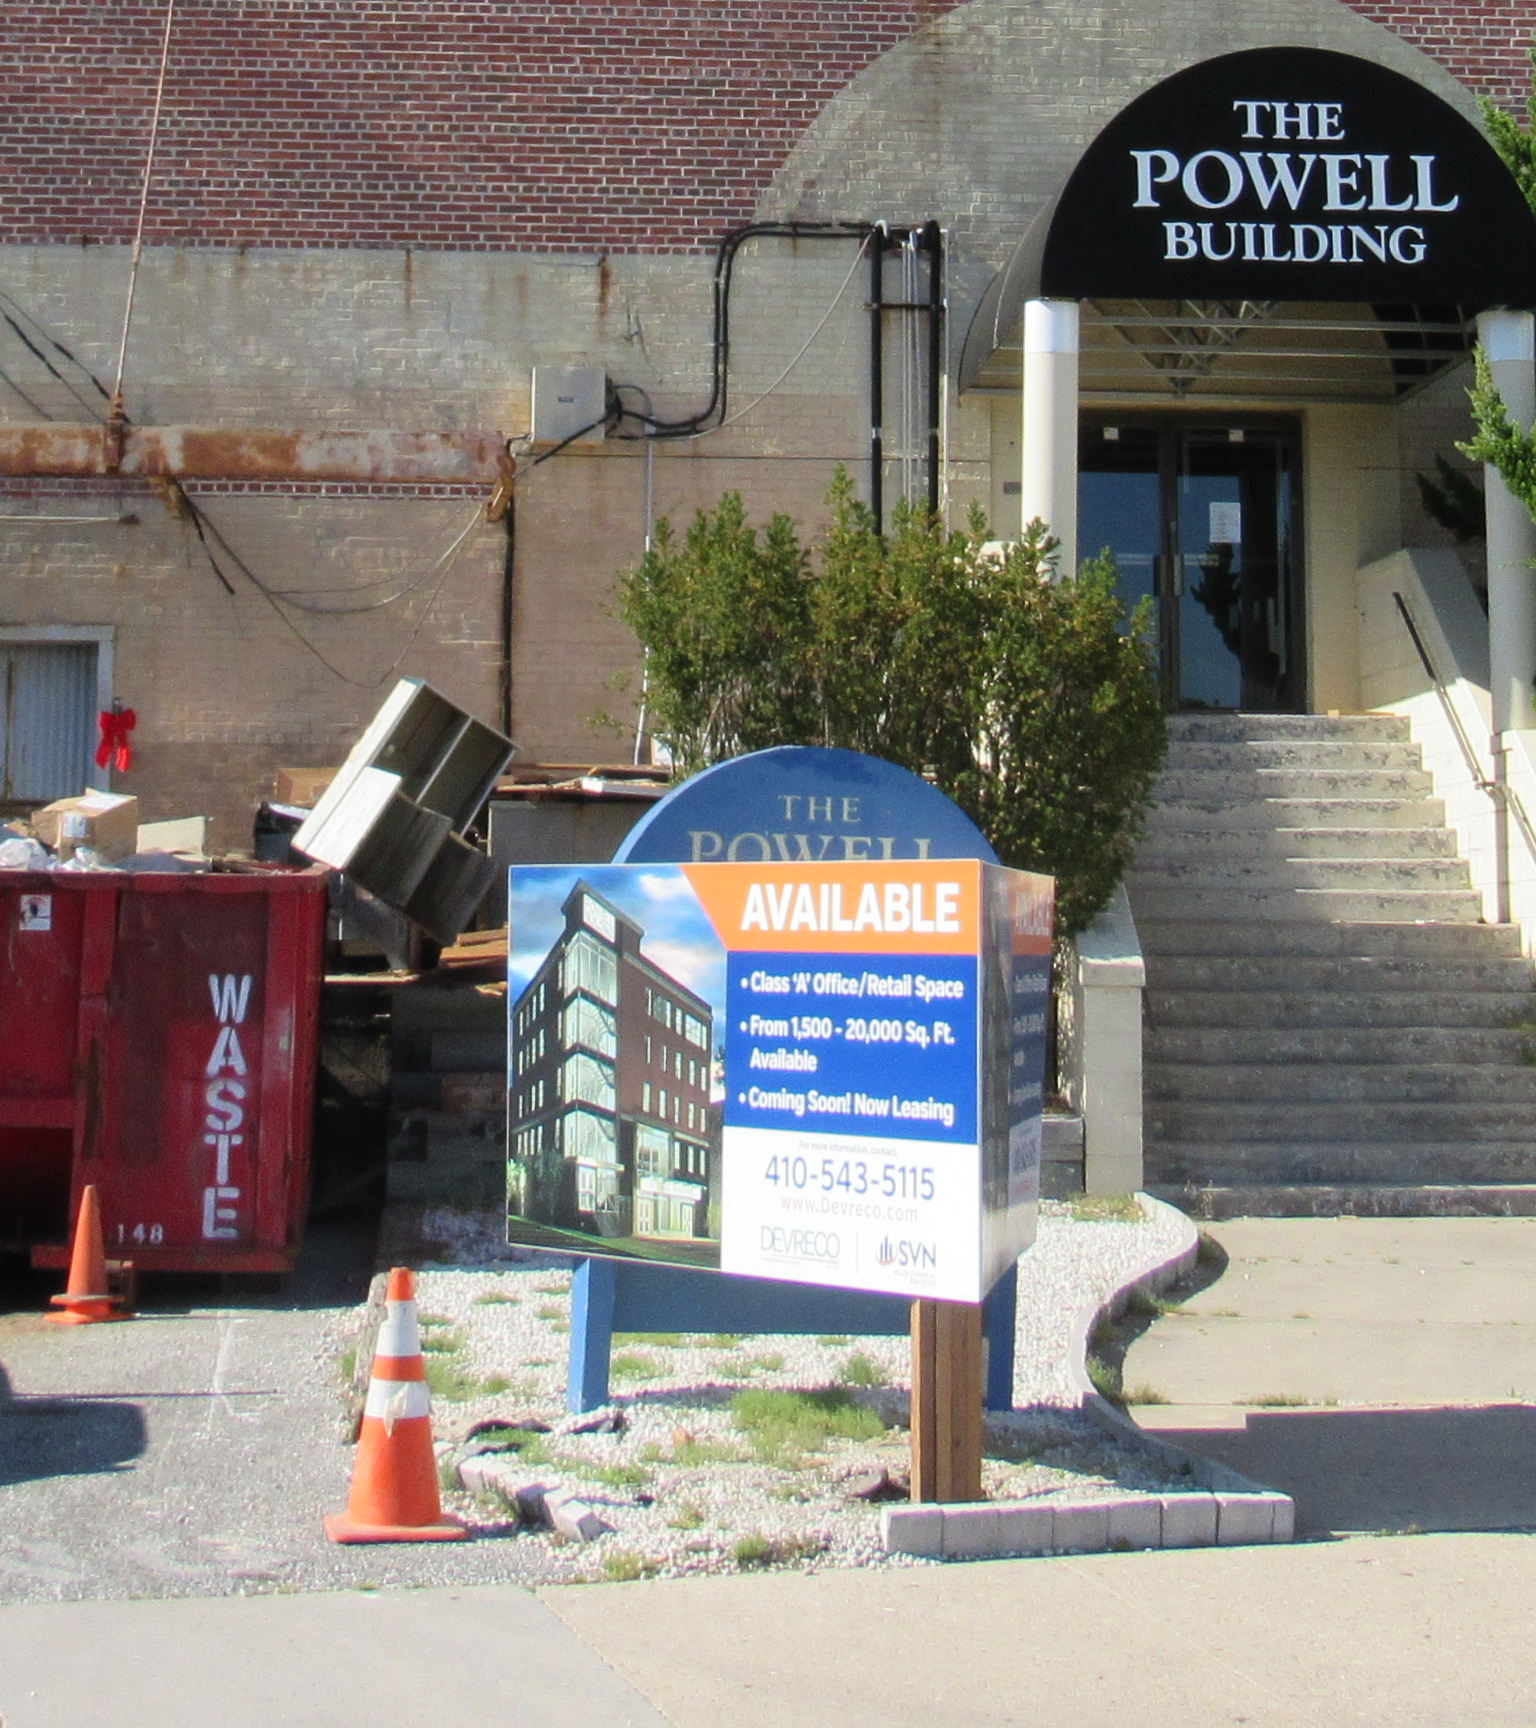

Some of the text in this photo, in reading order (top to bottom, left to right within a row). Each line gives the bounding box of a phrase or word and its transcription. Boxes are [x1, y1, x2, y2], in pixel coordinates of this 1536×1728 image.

[1233, 100, 1346, 141] THE
[1129, 149, 1460, 212] POWELL
[1162, 221, 1428, 264] BUILDING
[777, 794, 862, 823] THE
[740, 882, 960, 933] AVAILABLE
[750, 971, 790, 994] Class
[813, 971, 912, 998] Office/Retail
[914, 974, 964, 1003] Space
[750, 1014, 788, 1037] From
[791, 1016, 832, 1040] 1,500
[844, 1018, 903, 1044] 20,000
[905, 1020, 931, 1049] Sq.
[933, 1021, 956, 1045] Ft.
[749, 1047, 818, 1072] Available
[202, 973, 253, 1239] WASTE
[748, 1086, 955, 1127] Coming Soon! Now Leasing
[799, 1139, 810, 1149] For
[764, 1154, 935, 1201] 410-543-5115
[780, 1195, 919, 1223] www.Devreco.com
[117, 1223, 164, 1246] 148
[760, 1225, 937, 1269] DEVRECO SVN
